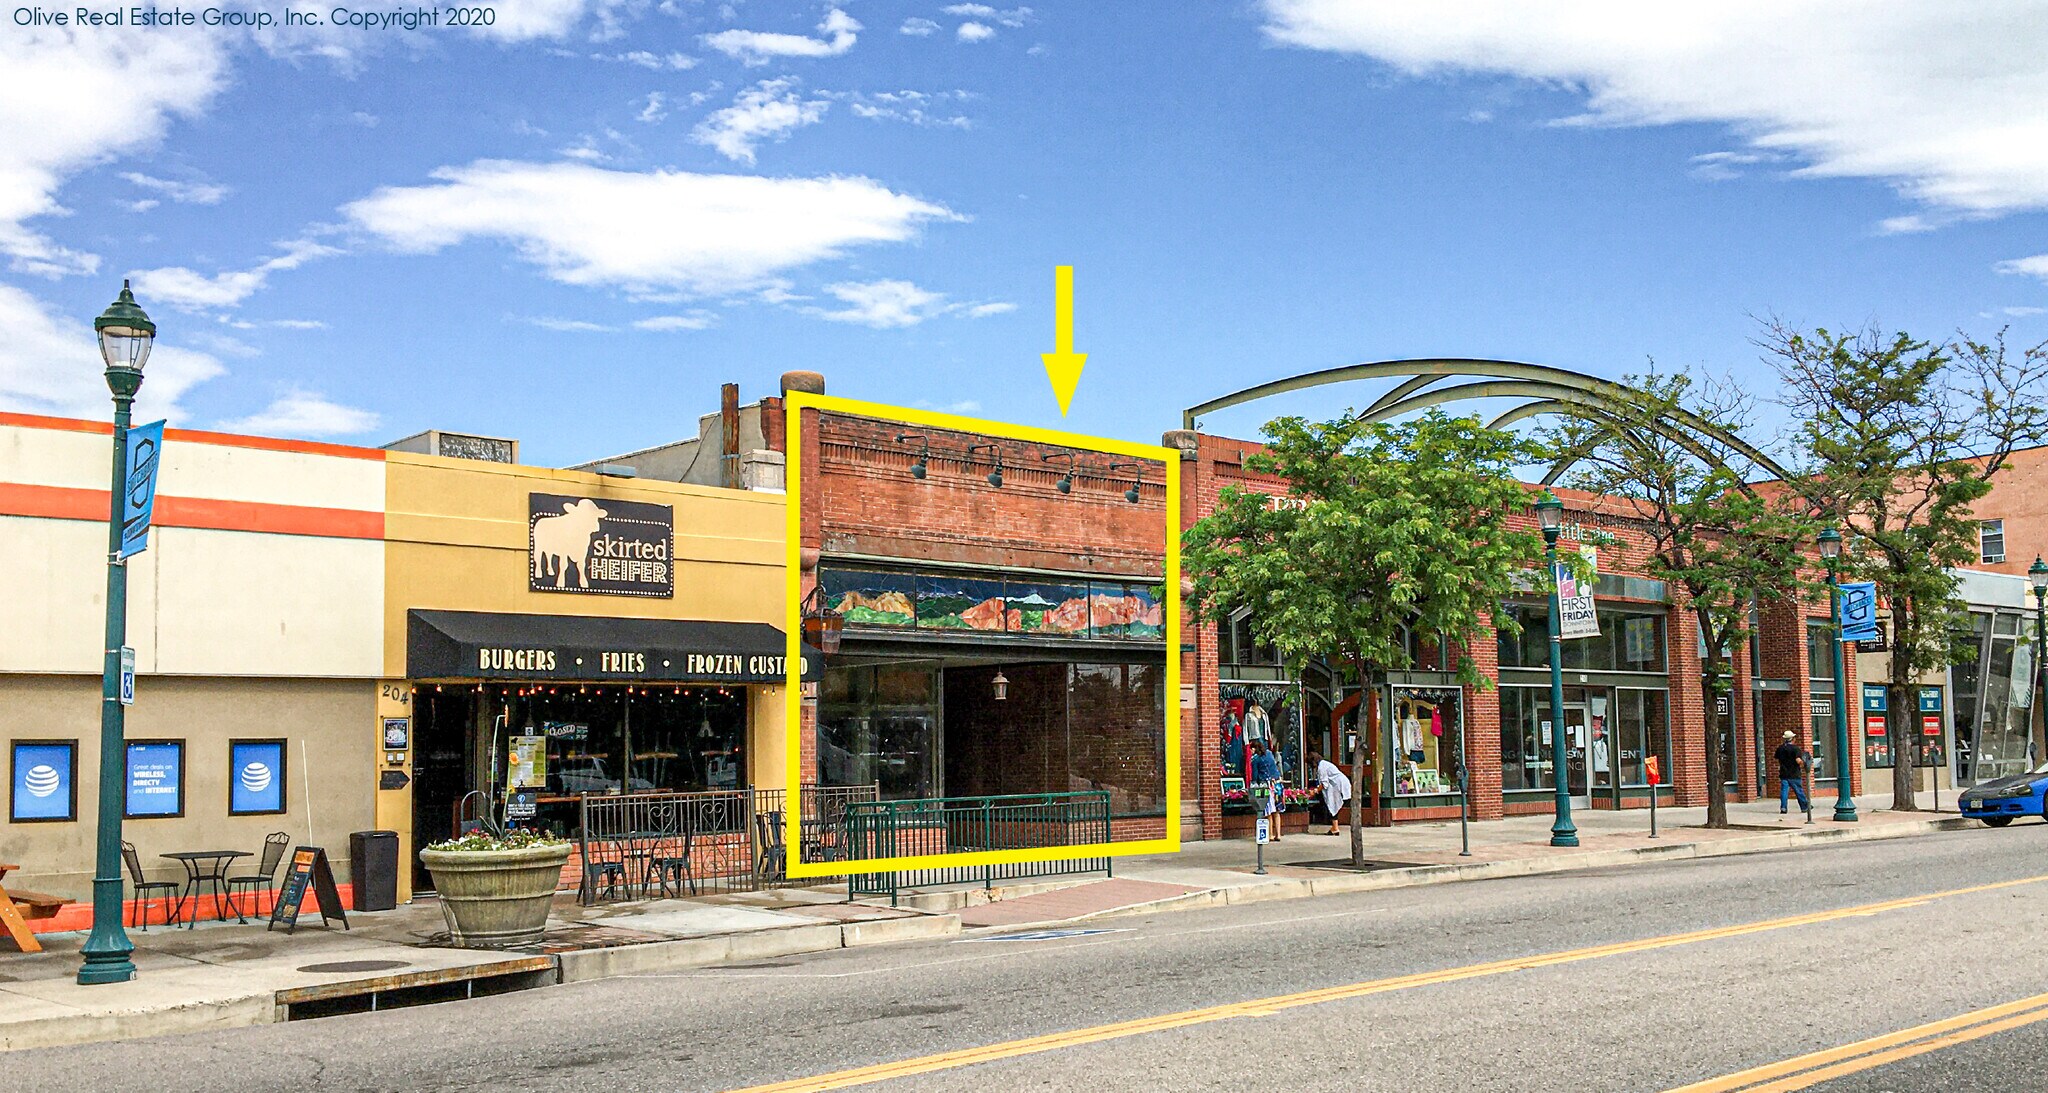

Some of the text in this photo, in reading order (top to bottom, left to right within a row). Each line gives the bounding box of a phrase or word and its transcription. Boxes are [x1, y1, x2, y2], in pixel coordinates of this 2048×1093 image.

[1559, 522, 1585, 540] title
[593, 533, 668, 561] skirted
[590, 558, 668, 583] HEIFER
[1561, 596, 1592, 611] FIRST
[1562, 610, 1595, 621] FRIDAY
[479, 648, 809, 677] BURGERS FRIES FROZEN CUSTAD
[383, 684, 409, 705] 204
[549, 724, 576, 737] CLOSED
